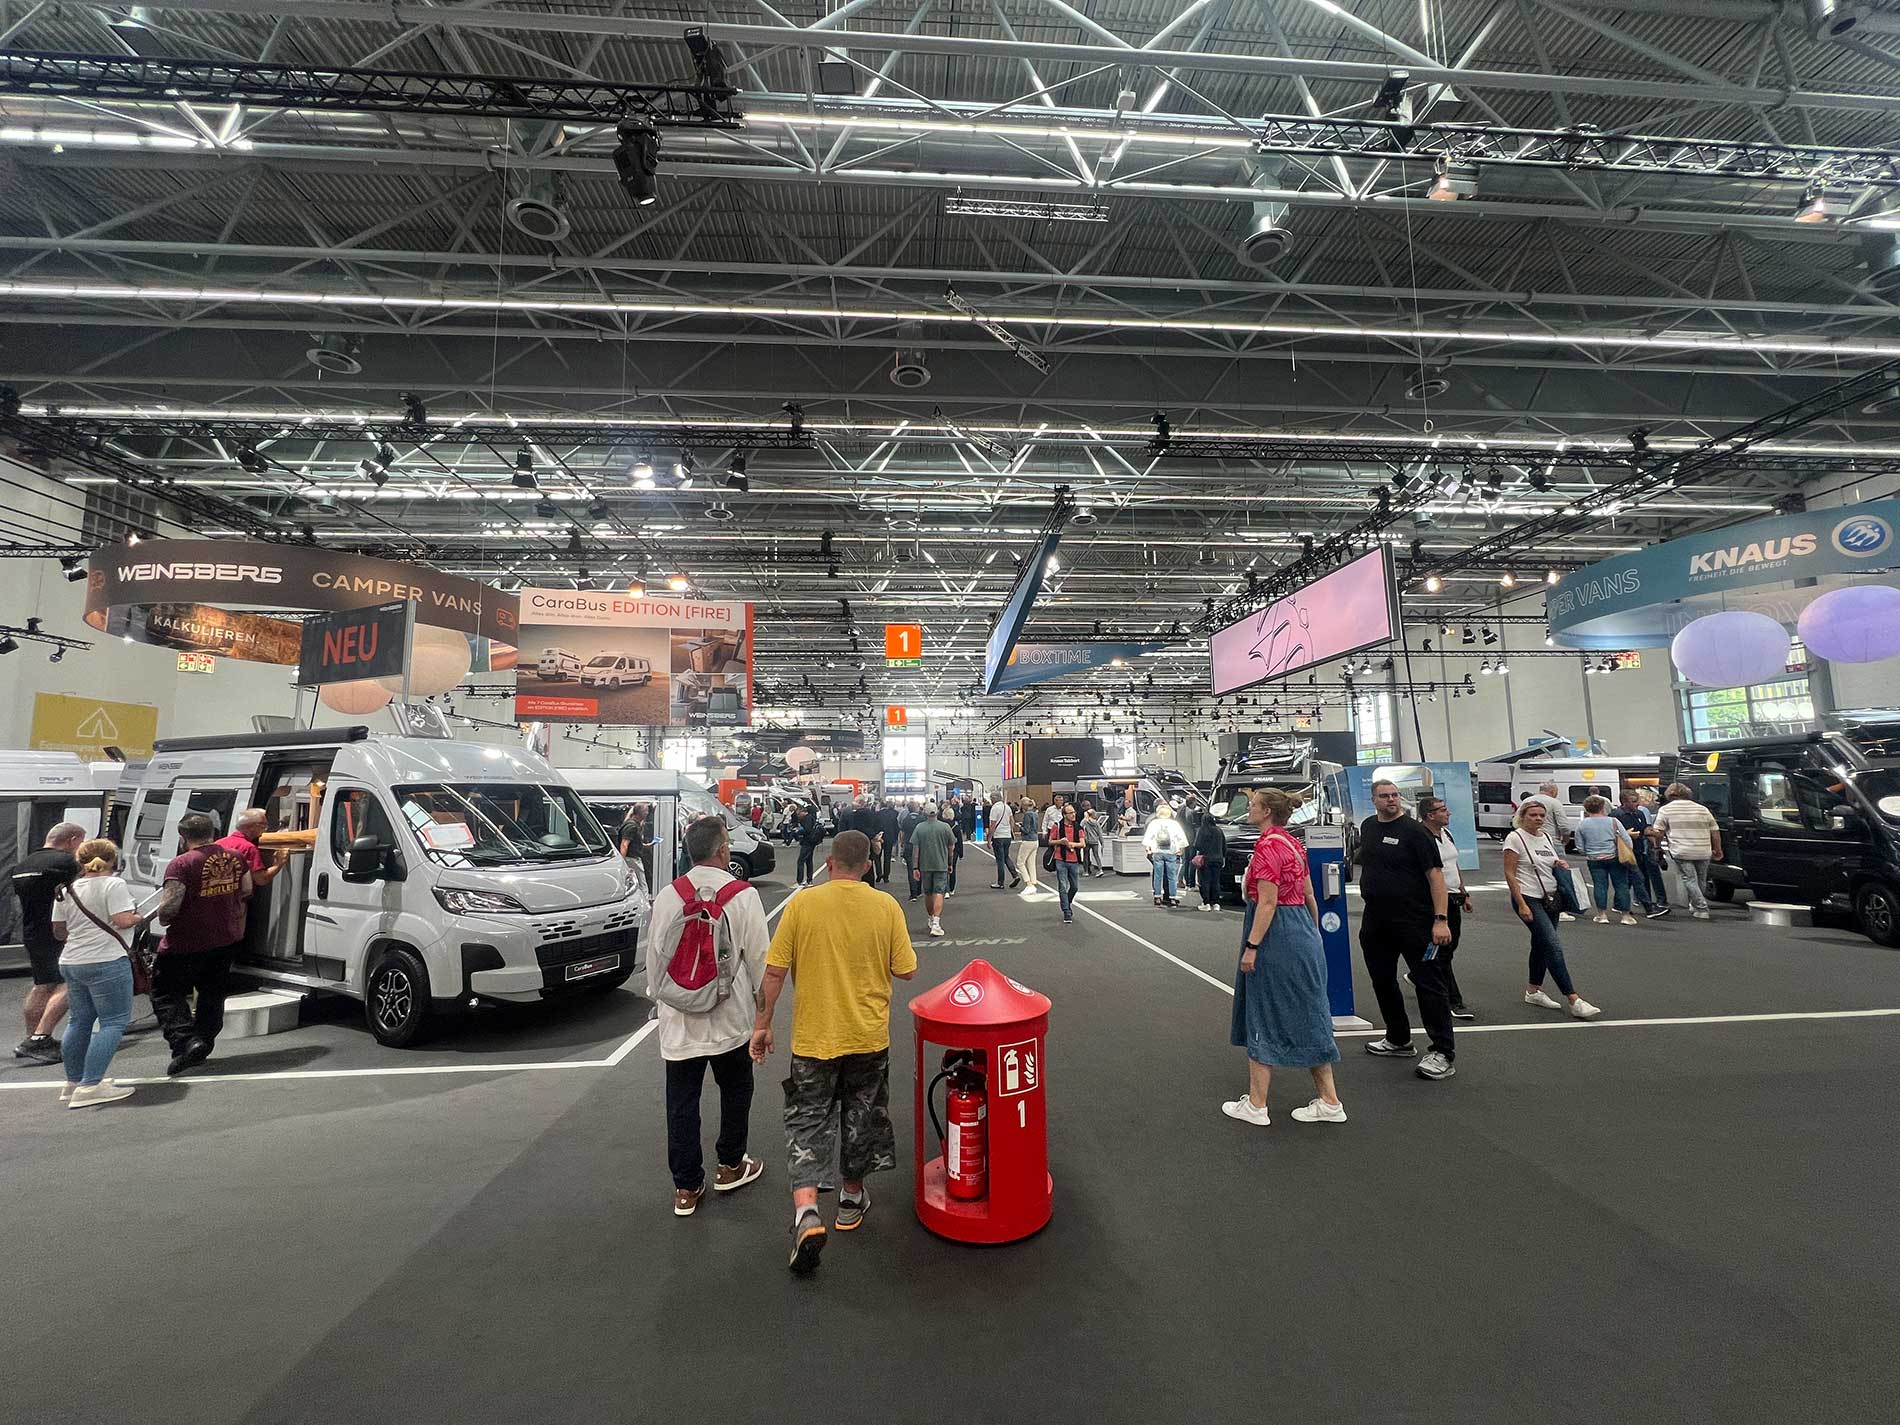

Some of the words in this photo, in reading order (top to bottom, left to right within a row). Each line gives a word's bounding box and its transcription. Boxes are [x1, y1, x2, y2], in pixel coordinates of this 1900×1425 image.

[1689, 533, 1817, 575] KNAUS
[118, 563, 283, 584] WEINSBERG
[1730, 566, 1744, 576] DIE
[312, 572, 424, 602] CAMPER
[431, 590, 482, 616] VANS
[1576, 568, 1641, 607] VANS
[531, 595, 607, 612] CaraBus
[613, 600, 681, 617] EDITION
[685, 605, 731, 622] [FIRE]
[154, 615, 260, 645] KALKULIEREN.
[322, 622, 379, 666] NEU
[899, 630, 908, 652] 1
[1020, 649, 1092, 665] BOXTIME
[895, 709, 901, 721] 1
[1017, 1099, 1026, 1128] 1
